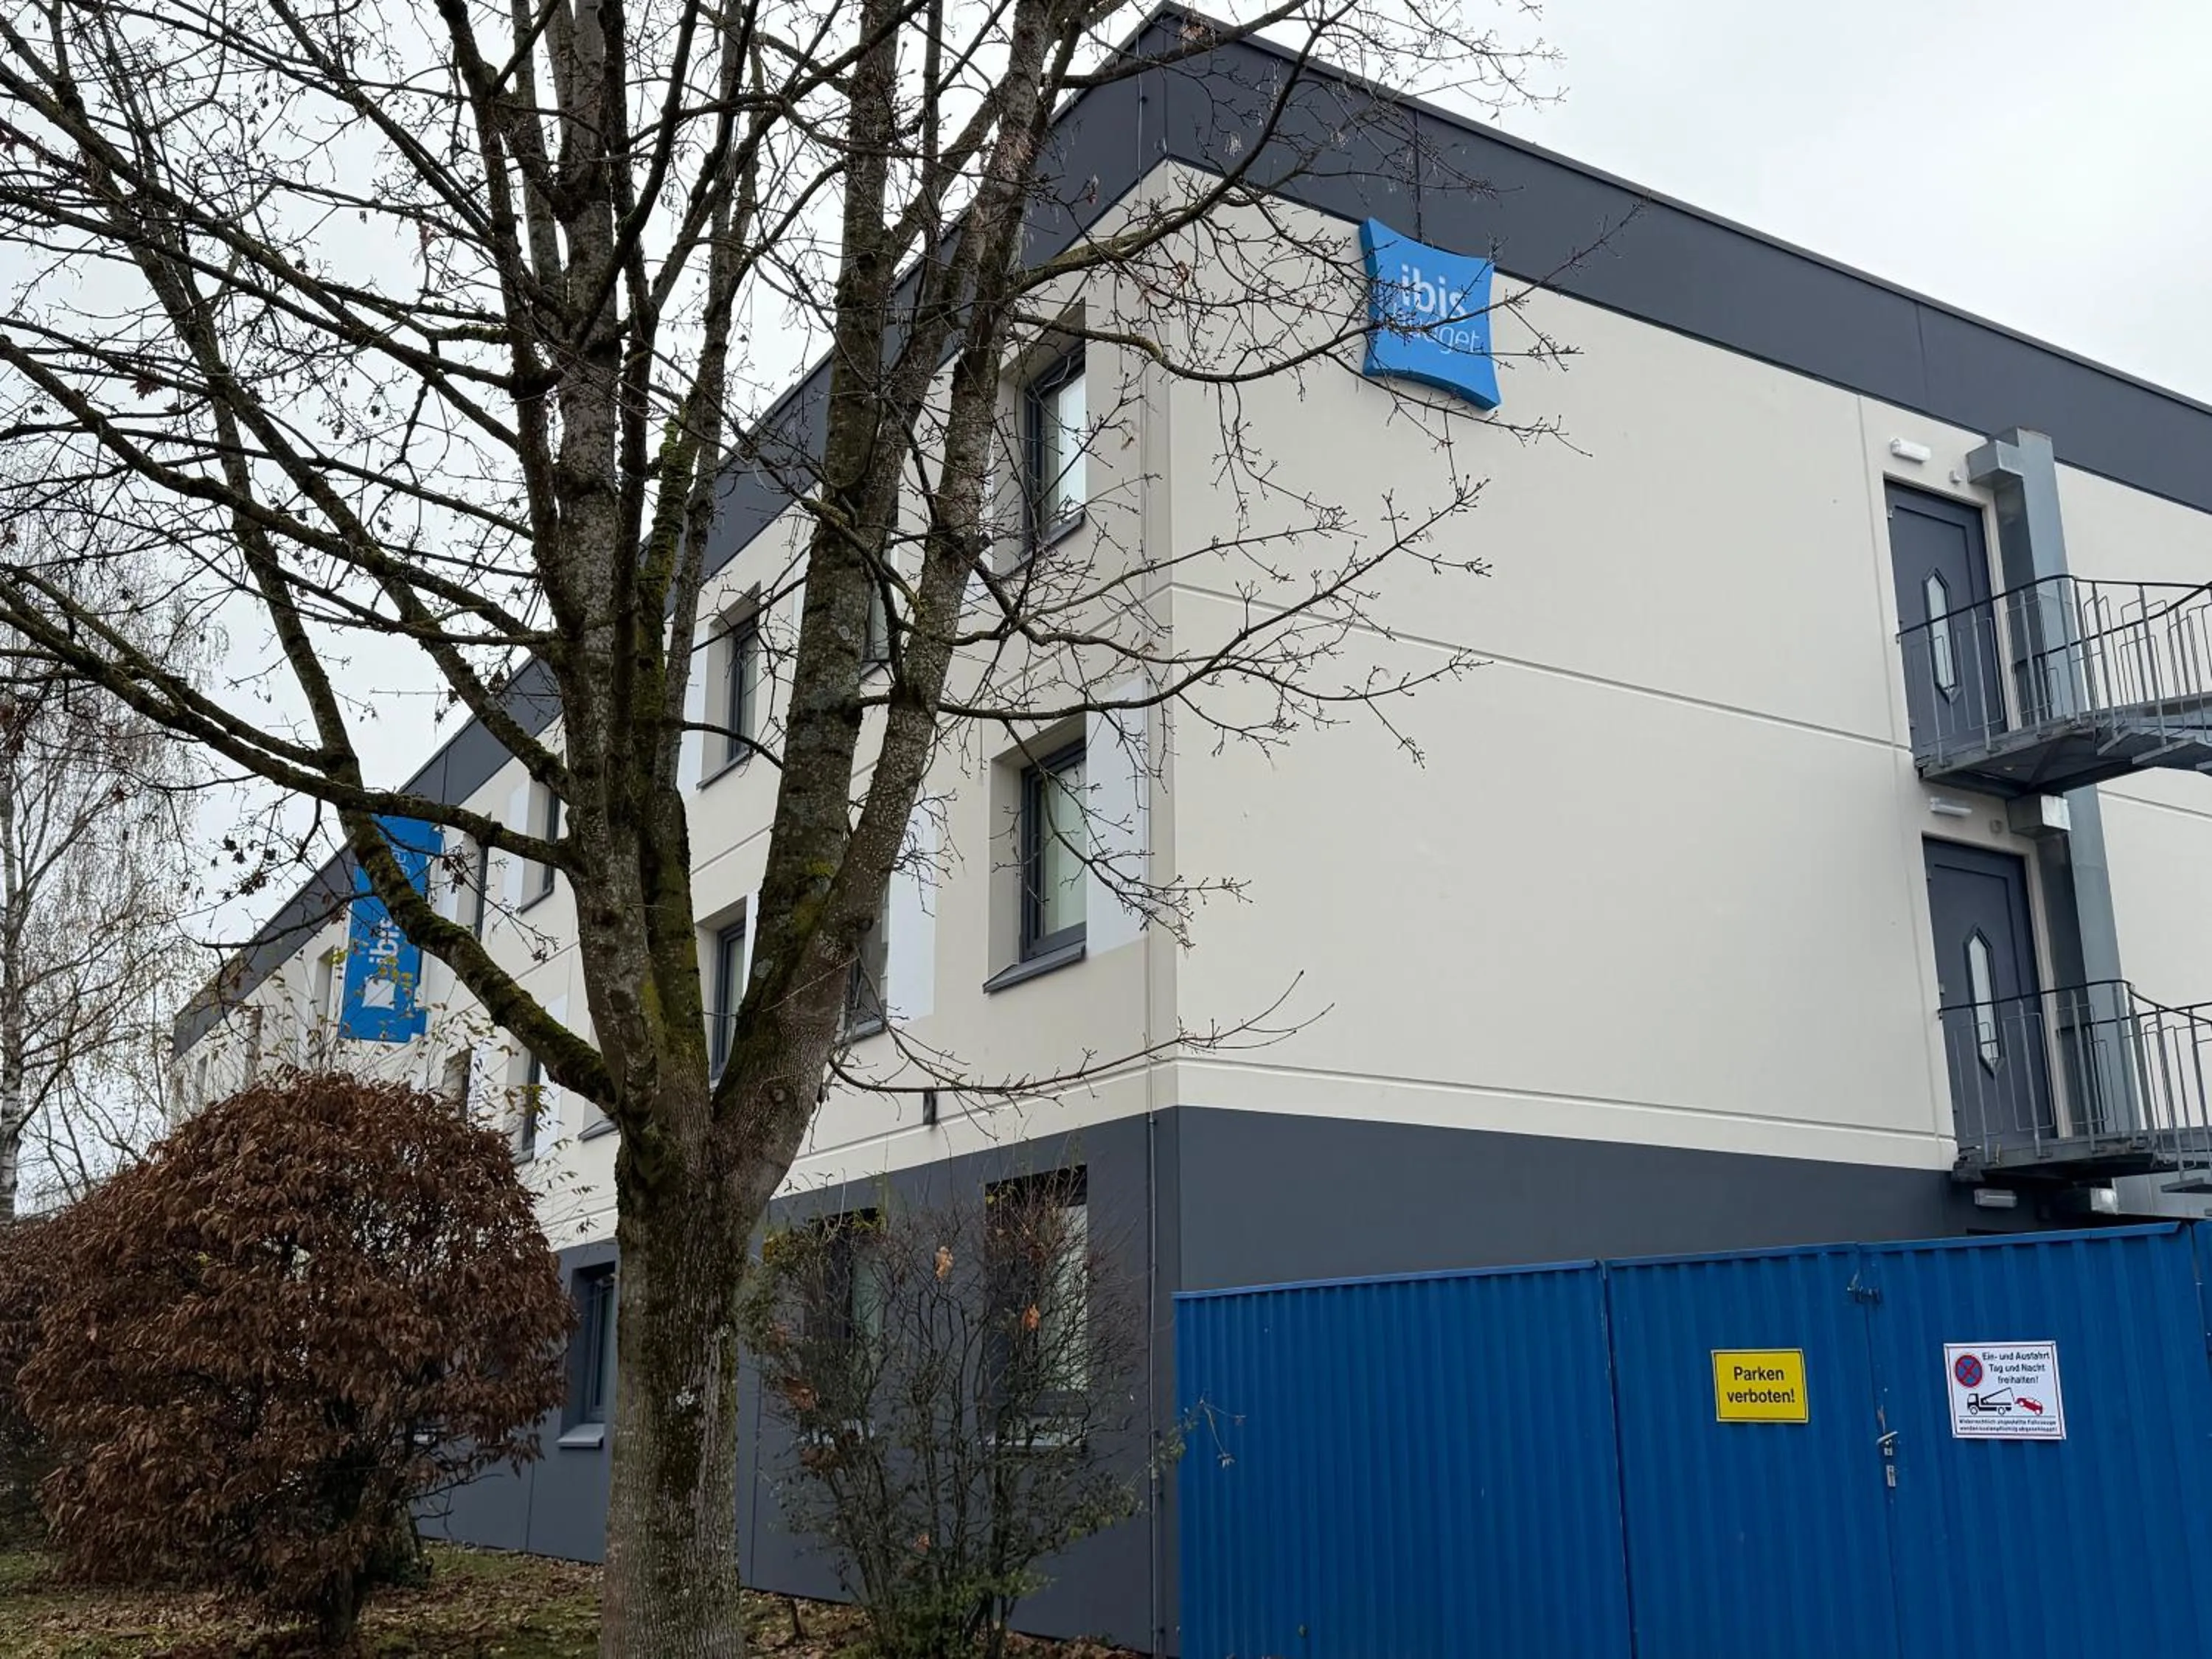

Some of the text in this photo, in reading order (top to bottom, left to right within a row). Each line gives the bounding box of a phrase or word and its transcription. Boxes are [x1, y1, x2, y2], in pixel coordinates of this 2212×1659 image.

[1402, 263, 1468, 323] ibis
[1982, 1351, 2050, 1360] Ein- und Ausfahrt
[1733, 1366, 1784, 1381] Parken
[1988, 1363, 2045, 1374] Tag und Nacht
[1727, 1388, 1796, 1403] verboten!
